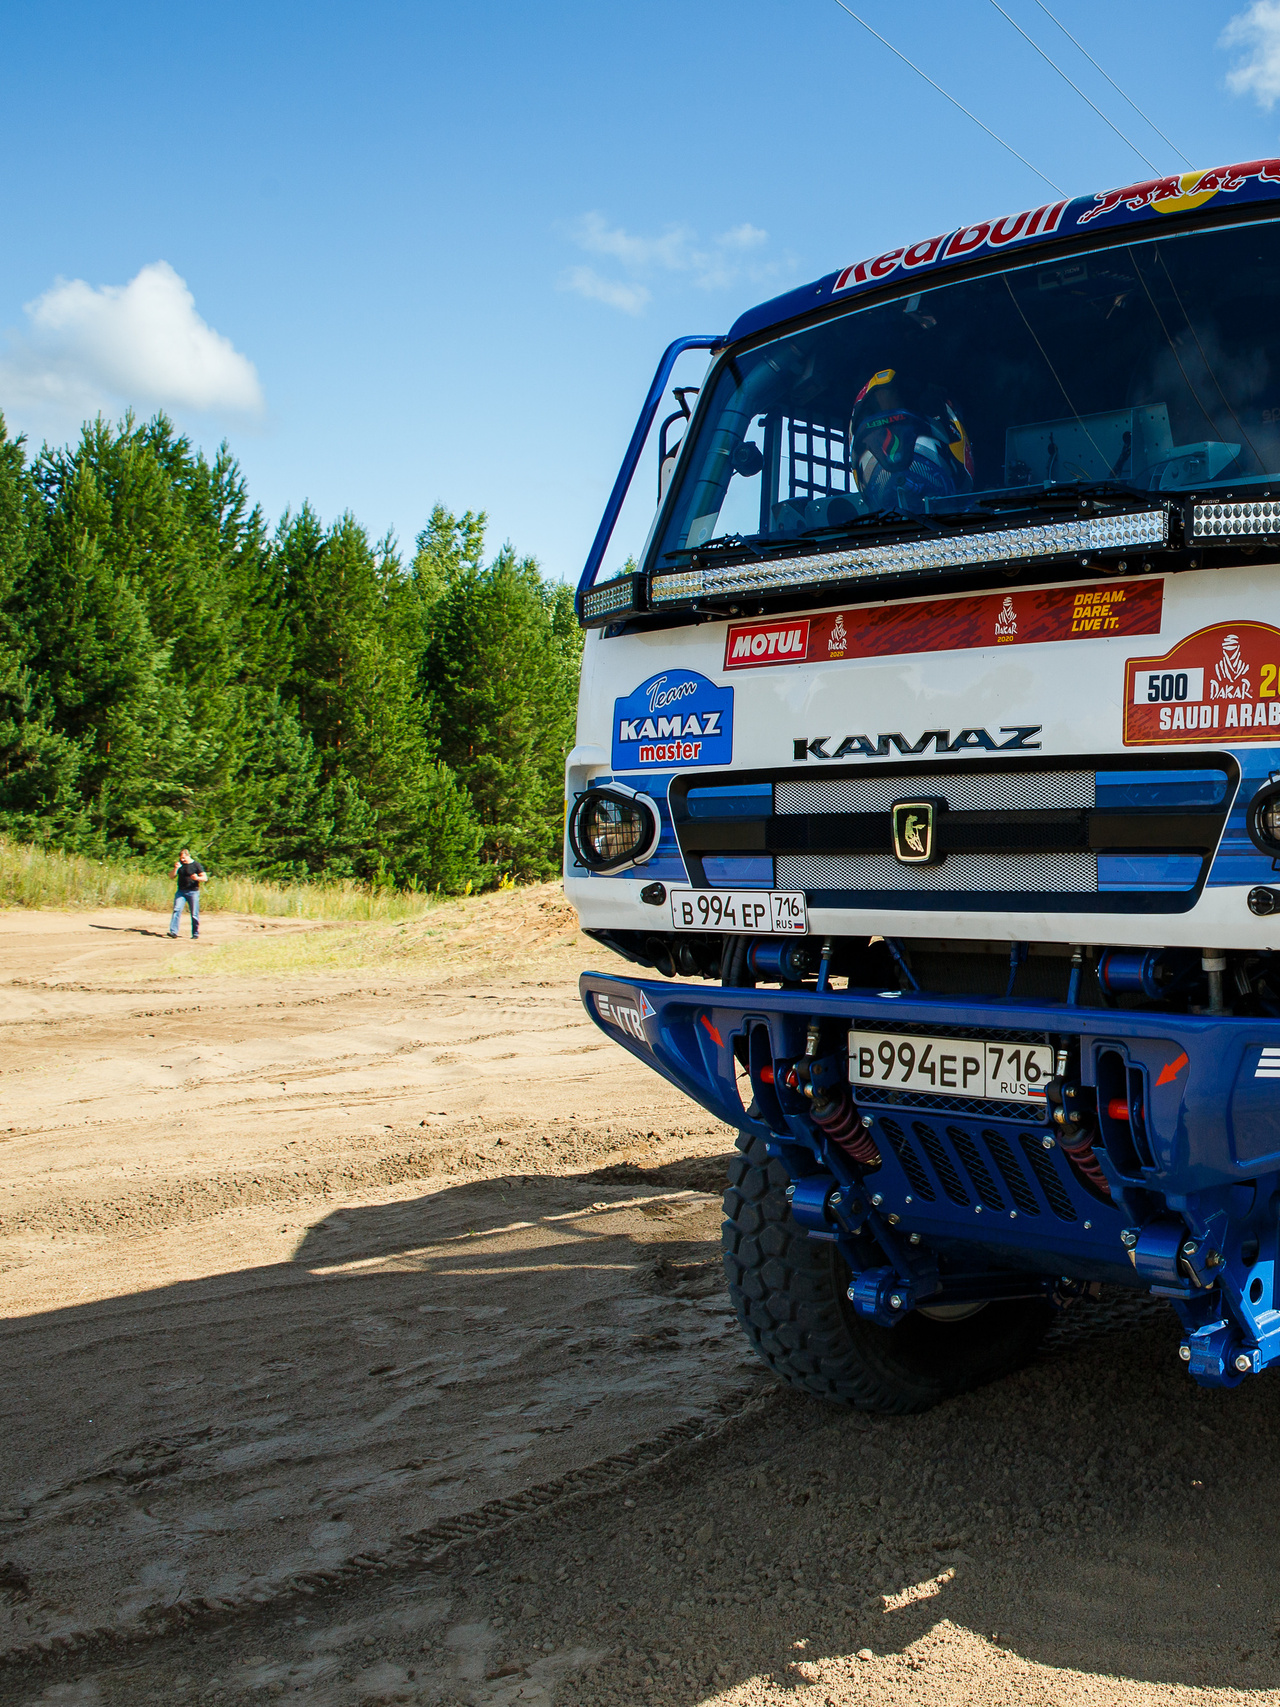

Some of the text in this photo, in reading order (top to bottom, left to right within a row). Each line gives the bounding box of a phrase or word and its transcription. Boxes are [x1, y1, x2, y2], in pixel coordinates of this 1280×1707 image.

[1074, 590, 1126, 606] DREAM.
[1072, 605, 1113, 619] DARE.
[1071, 617, 1120, 632] LIVE IT.
[732, 630, 803, 658] MOTUL
[997, 635, 1014, 643] 2020
[830, 650, 844, 658] 2020
[646, 676, 697, 712] Team
[1147, 673, 1188, 702] 500
[1210, 678, 1252, 700] DAKAR
[619, 712, 722, 742] KAMAZ
[1159, 704, 1219, 730] SAUDI
[639, 740, 702, 762] master
[793, 724, 1042, 761] KAMAZ
[775, 897, 799, 916] 716
[776, 920, 793, 929] RUS
[610, 1004, 646, 1042] VTB
[988, 1047, 1042, 1083] 716
[1000, 1082, 1027, 1095] RUS
